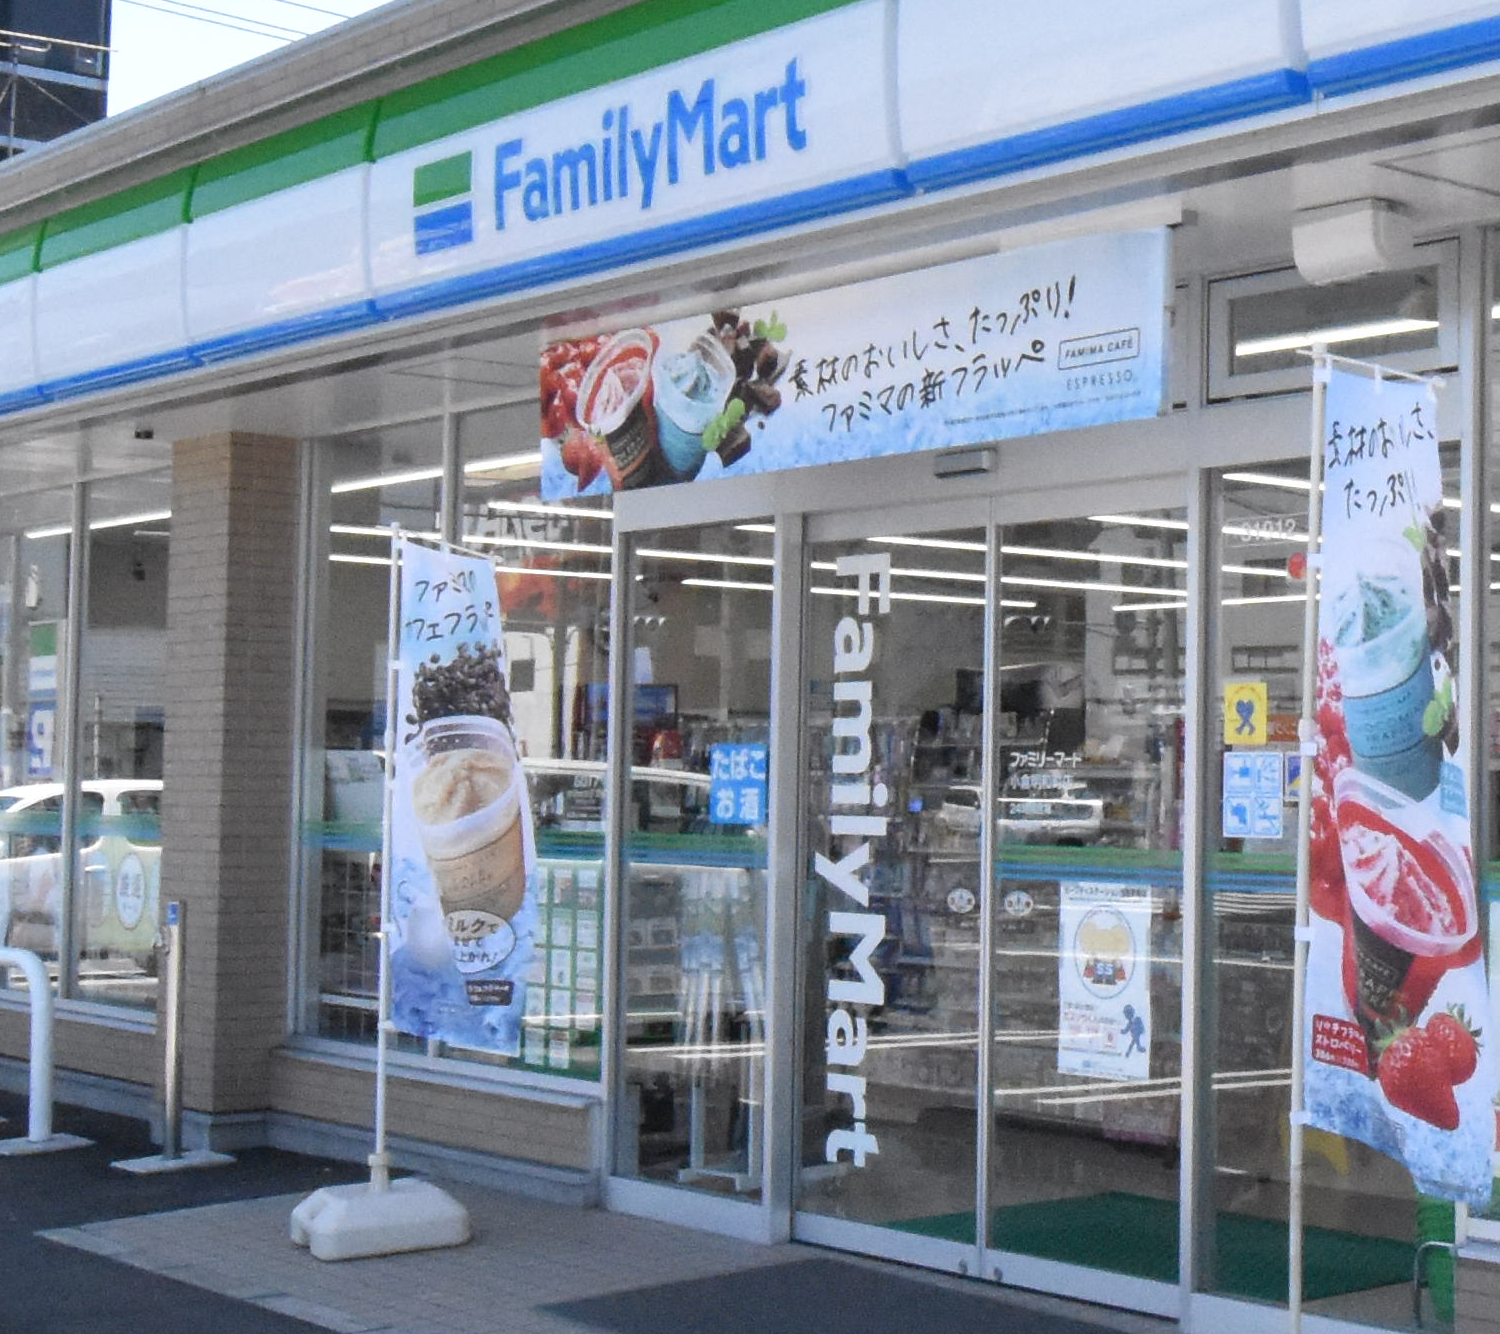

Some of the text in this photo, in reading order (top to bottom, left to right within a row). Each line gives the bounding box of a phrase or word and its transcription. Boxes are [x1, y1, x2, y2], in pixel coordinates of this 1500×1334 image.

[494, 56, 807, 230] FamilyMart
[1065, 343, 1104, 360] FAMIMA
[1066, 369, 1133, 391] ESPRESSO
[711, 748, 767, 780] たばこ
[1009, 750, 1083, 769] ファミリーマート
[715, 787, 760, 820] お酒
[813, 552, 892, 1168] FamilyMart
